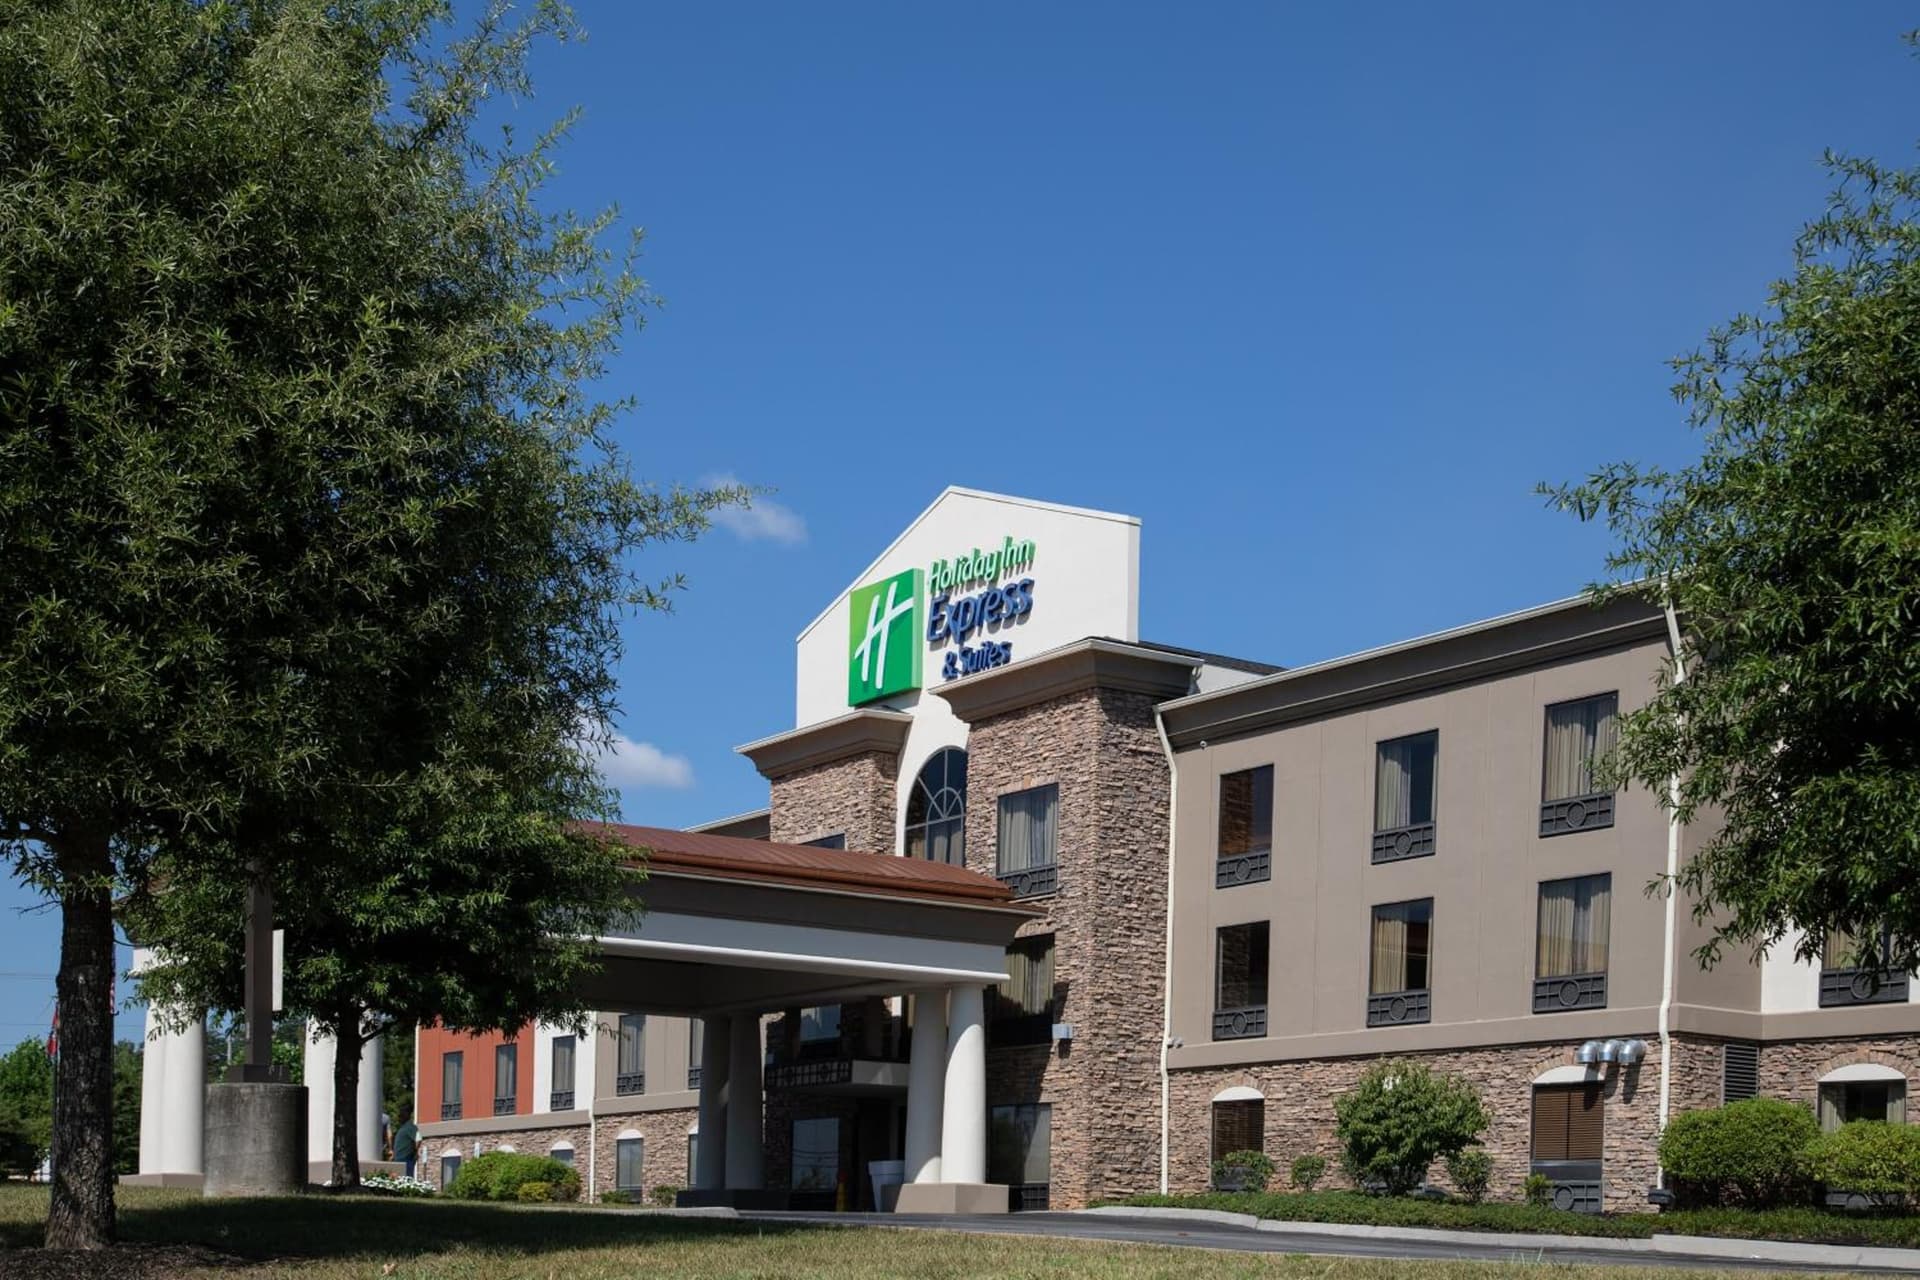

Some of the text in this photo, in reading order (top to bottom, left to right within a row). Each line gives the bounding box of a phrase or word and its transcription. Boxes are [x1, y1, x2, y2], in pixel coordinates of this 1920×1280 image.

[928, 536, 1036, 594] Holiday Inn
[927, 578, 1035, 644] Express
[942, 641, 1012, 680] & Suites
